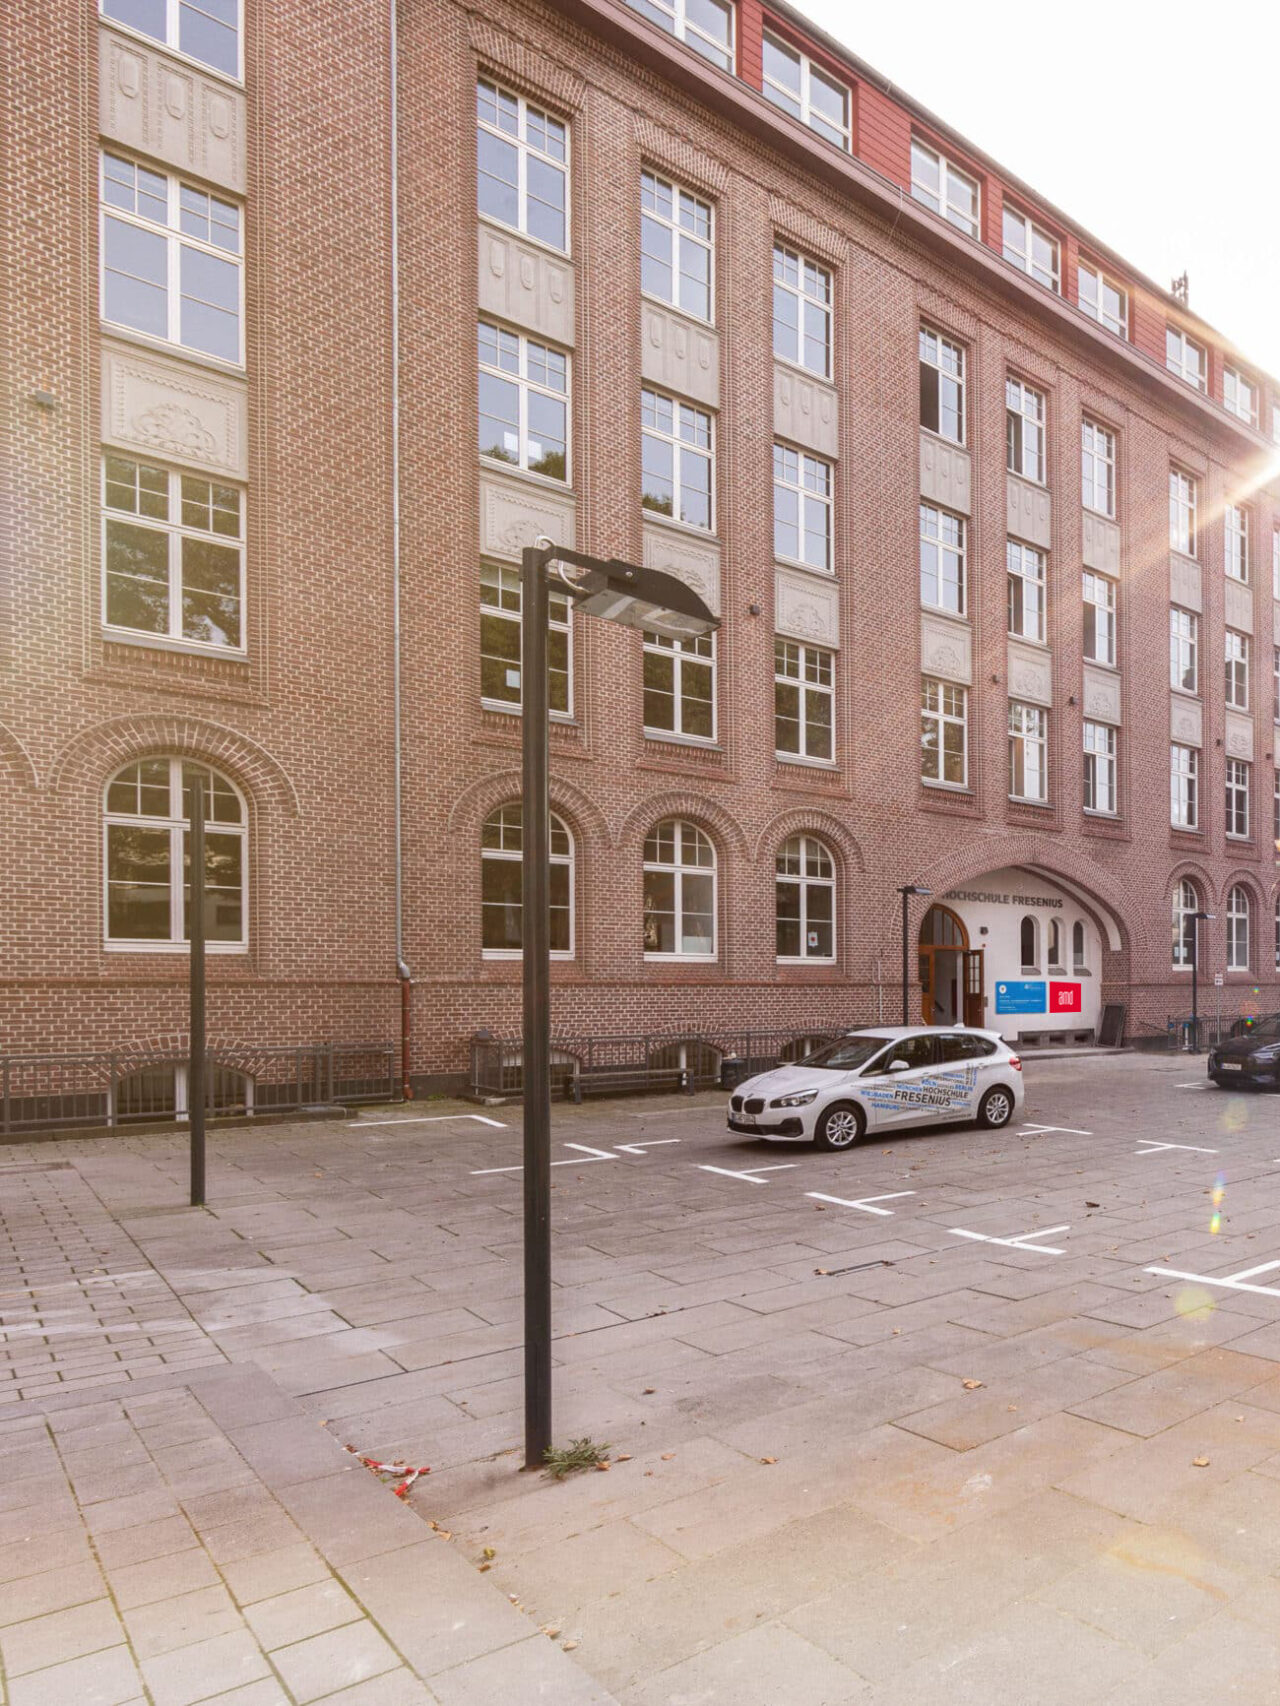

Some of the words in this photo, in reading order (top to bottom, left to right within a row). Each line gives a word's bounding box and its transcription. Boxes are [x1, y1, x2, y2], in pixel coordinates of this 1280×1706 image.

[942, 890, 1010, 905] HOCHSCHULE
[1012, 895, 1063, 908] FRESENIUS
[1058, 990, 1074, 1006] amd
[894, 1090, 951, 1107] FRESENIUS
[923, 1086, 969, 1099] HOCHSCHULE
